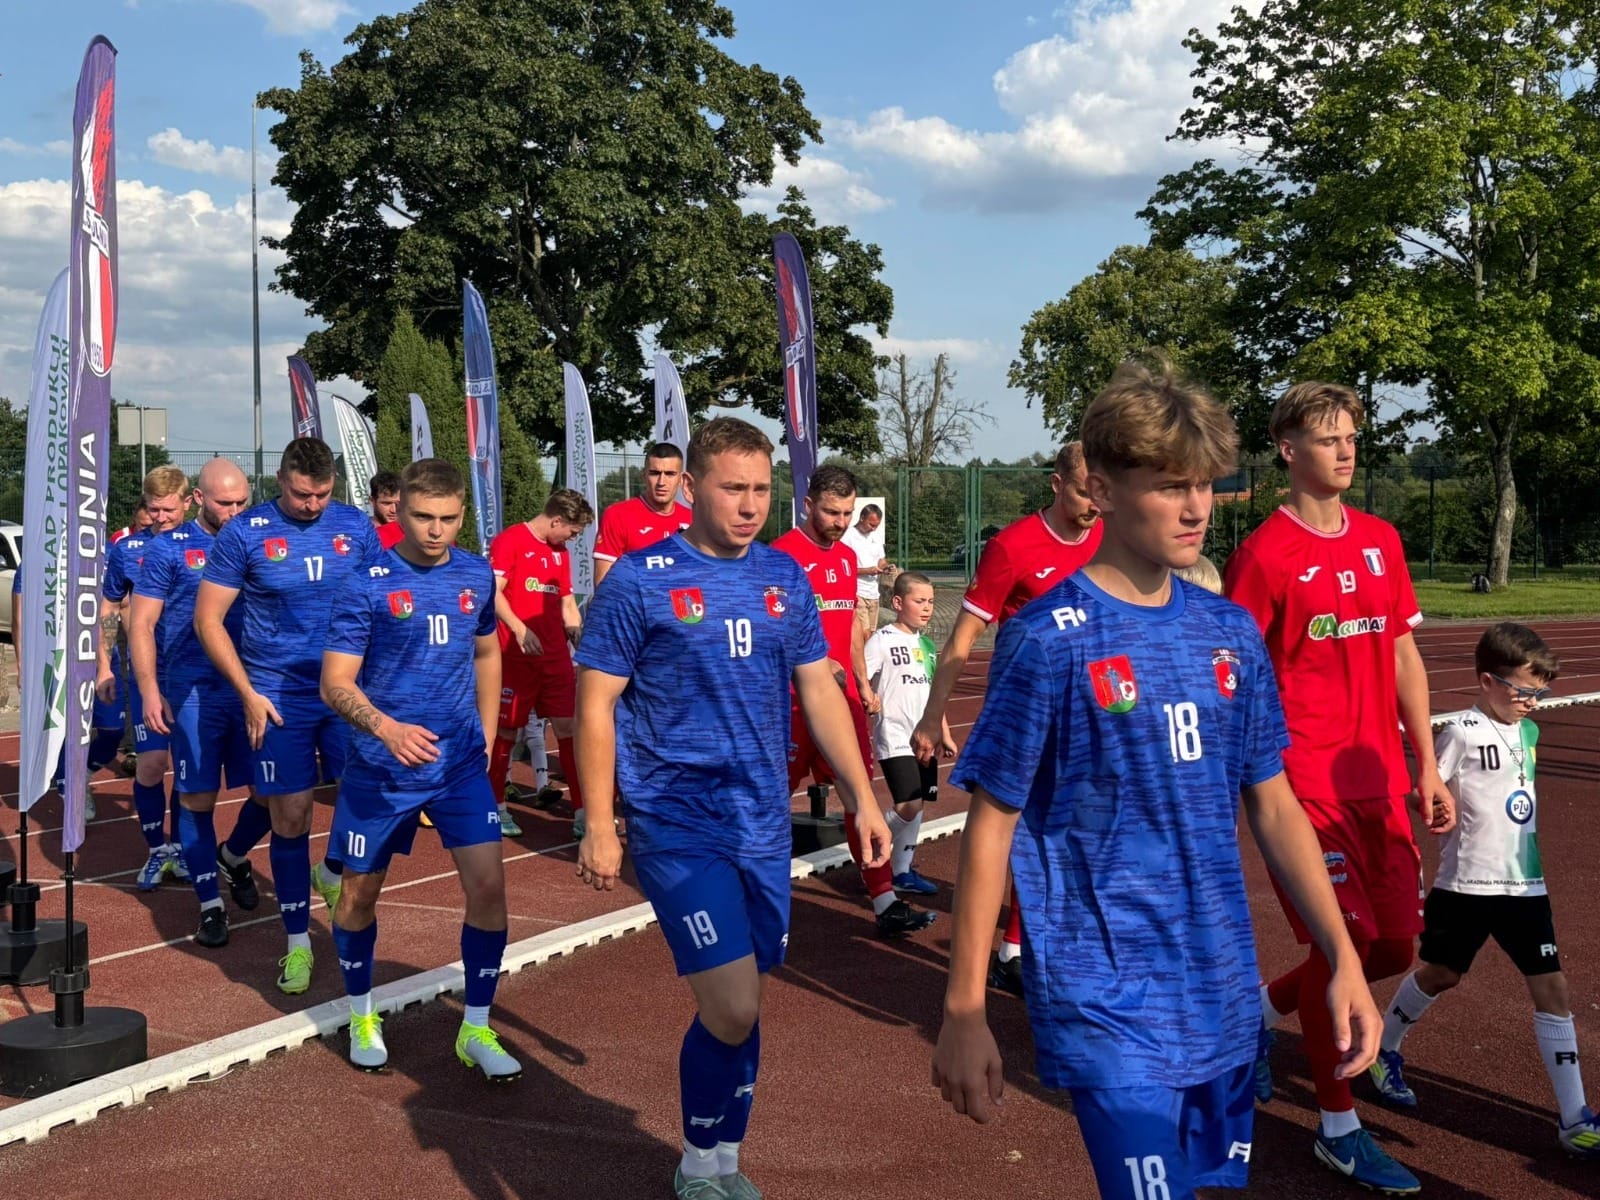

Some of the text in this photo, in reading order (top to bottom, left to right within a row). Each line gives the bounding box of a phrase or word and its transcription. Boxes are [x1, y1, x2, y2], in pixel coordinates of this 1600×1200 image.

[77, 432, 98, 661] POLONIA
[44, 514, 57, 637] ZAKŁAD
[303, 556, 323, 582] 17
[825, 569, 837, 584] 16
[1336, 570, 1358, 594] 19
[427, 614, 449, 645] 10
[725, 618, 753, 658] 19
[890, 646, 911, 666] 55
[134, 724, 148, 743] 16
[1163, 702, 1203, 763] 18
[178, 759, 187, 781] 3
[1477, 744, 1500, 771] 10
[260, 760, 276, 783] 17
[1513, 800, 1529, 815] PZU
[347, 831, 366, 858] 10
[682, 910, 720, 950] 19
[1124, 1155, 1171, 1200] 18
